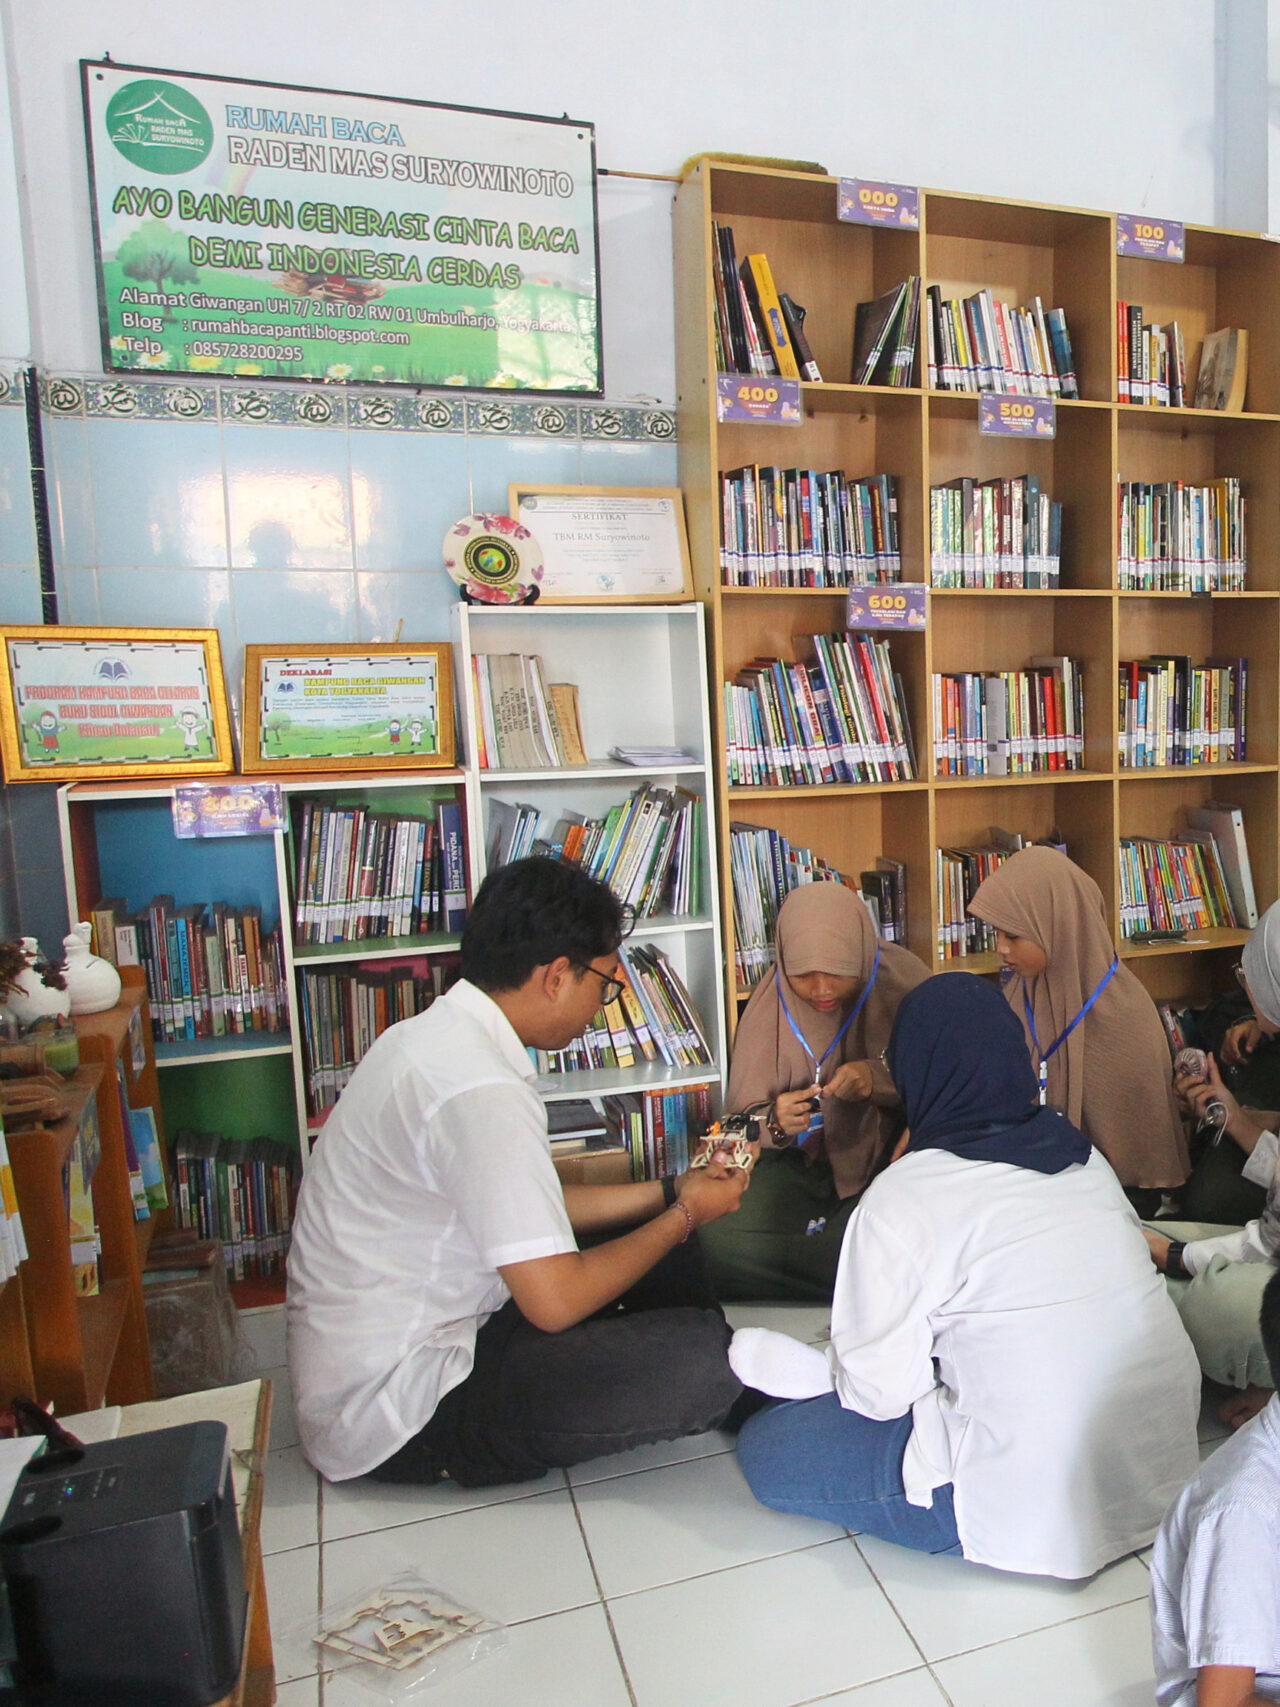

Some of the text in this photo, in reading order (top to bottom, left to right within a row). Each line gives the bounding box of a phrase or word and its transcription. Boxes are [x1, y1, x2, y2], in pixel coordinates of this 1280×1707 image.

[225, 104, 405, 147] RUMAH BACA
[228, 135, 574, 198] RADEN MAS SURYOWINOTO
[113, 186, 580, 254] AYO BANGUN GENERASI CINTA BACA
[1134, 224, 1164, 240] 100
[188, 235, 521, 289] DEMI INDONESIA CERDAS
[120, 287, 185, 307] Alamat
[189, 293, 263, 315] Giwangan
[267, 298, 290, 313] UH
[326, 303, 344, 317] RT
[347, 305, 364, 319] 02
[368, 306, 392, 321] RW
[395, 307, 413, 322] 01
[417, 308, 499, 330] Umbulharjo,
[121, 312, 164, 332] Blog
[191, 319, 410, 345] rumahbacapanti.blogspot.com
[123, 336, 162, 355] Telp
[192, 340, 303, 361] 085728200295
[738, 386, 779, 403] 400
[1000, 402, 1035, 418] 500
[571, 512, 629, 521] SERTIFIKAT
[554, 532, 575, 541] TBM
[578, 533, 593, 541] RM
[868, 594, 907, 610] 600
